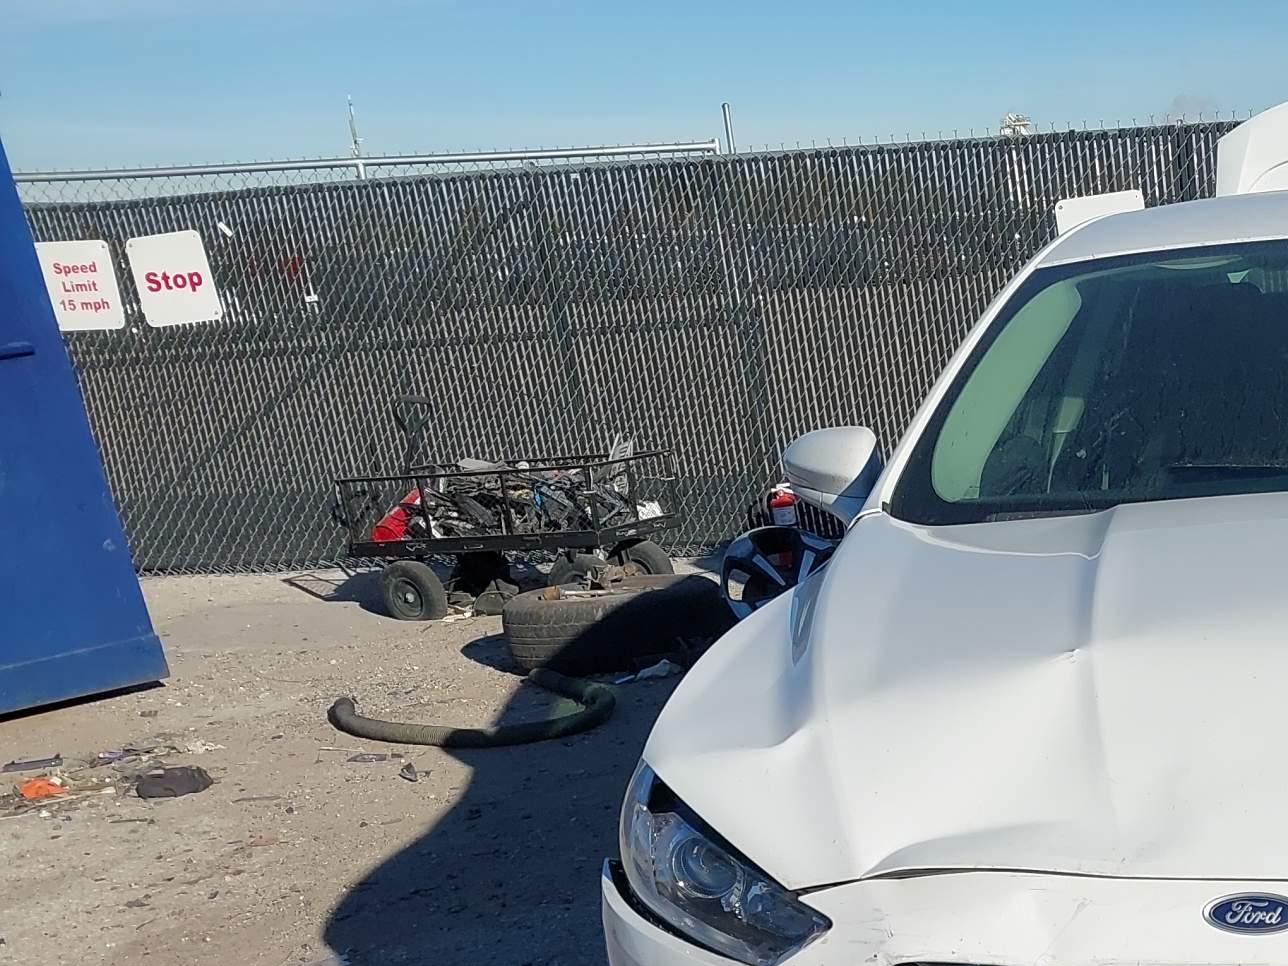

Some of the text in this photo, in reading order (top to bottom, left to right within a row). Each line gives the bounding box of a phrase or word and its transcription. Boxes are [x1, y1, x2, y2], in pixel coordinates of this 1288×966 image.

[53, 262, 97, 276] Speed
[62, 280, 98, 293] Limit
[145, 271, 203, 292] Stop
[60, 298, 110, 313] 15 mph
[1225, 900, 1283, 924] Ford
